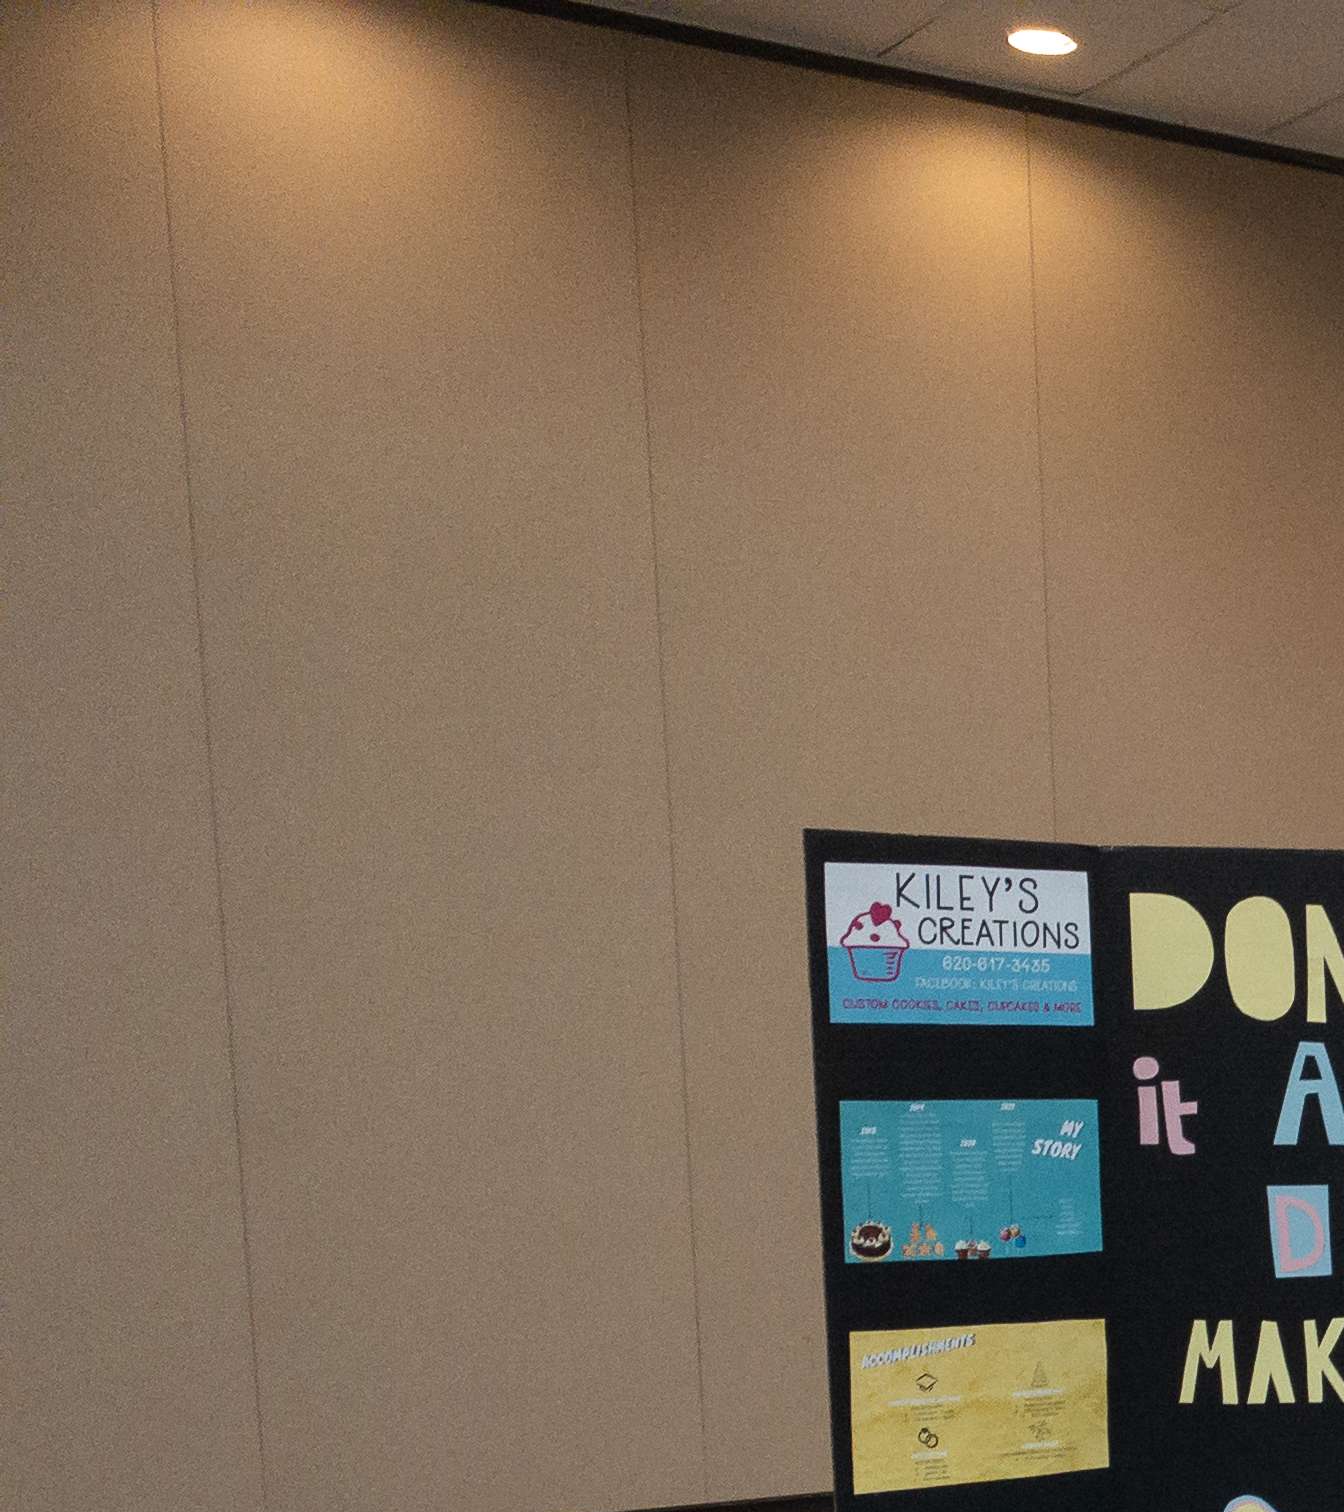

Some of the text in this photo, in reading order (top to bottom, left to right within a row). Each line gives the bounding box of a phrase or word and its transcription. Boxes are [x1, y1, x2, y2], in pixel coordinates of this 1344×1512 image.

[896, 872, 1039, 914] KILEY'S
[918, 916, 1080, 950] CREATIONS
[1022, 979, 1078, 993] CREATIONS
[1132, 1056, 1198, 1155] it
[1059, 1120, 1085, 1138] MY
[1031, 1139, 1082, 1161] STORY
